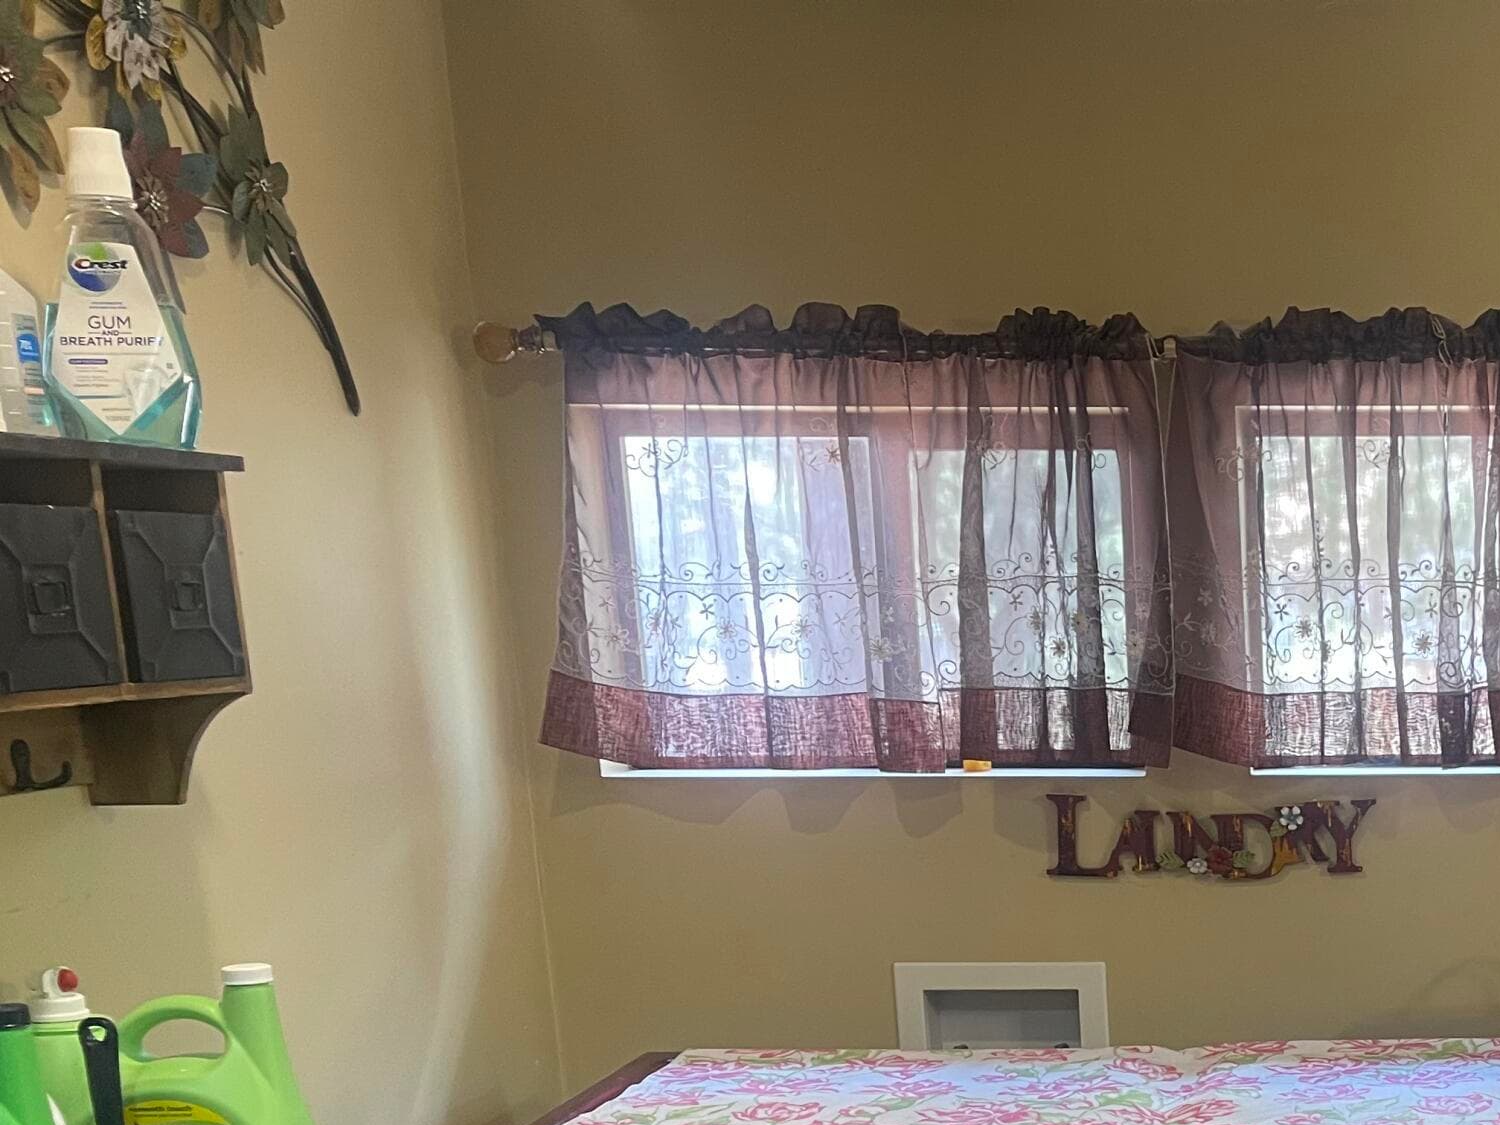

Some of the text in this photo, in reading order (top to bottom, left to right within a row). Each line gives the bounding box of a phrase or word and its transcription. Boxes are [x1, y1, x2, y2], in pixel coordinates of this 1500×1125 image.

[74, 258, 128, 270] Crest
[87, 315, 132, 329] GUM
[60, 336, 112, 346] BREATH
